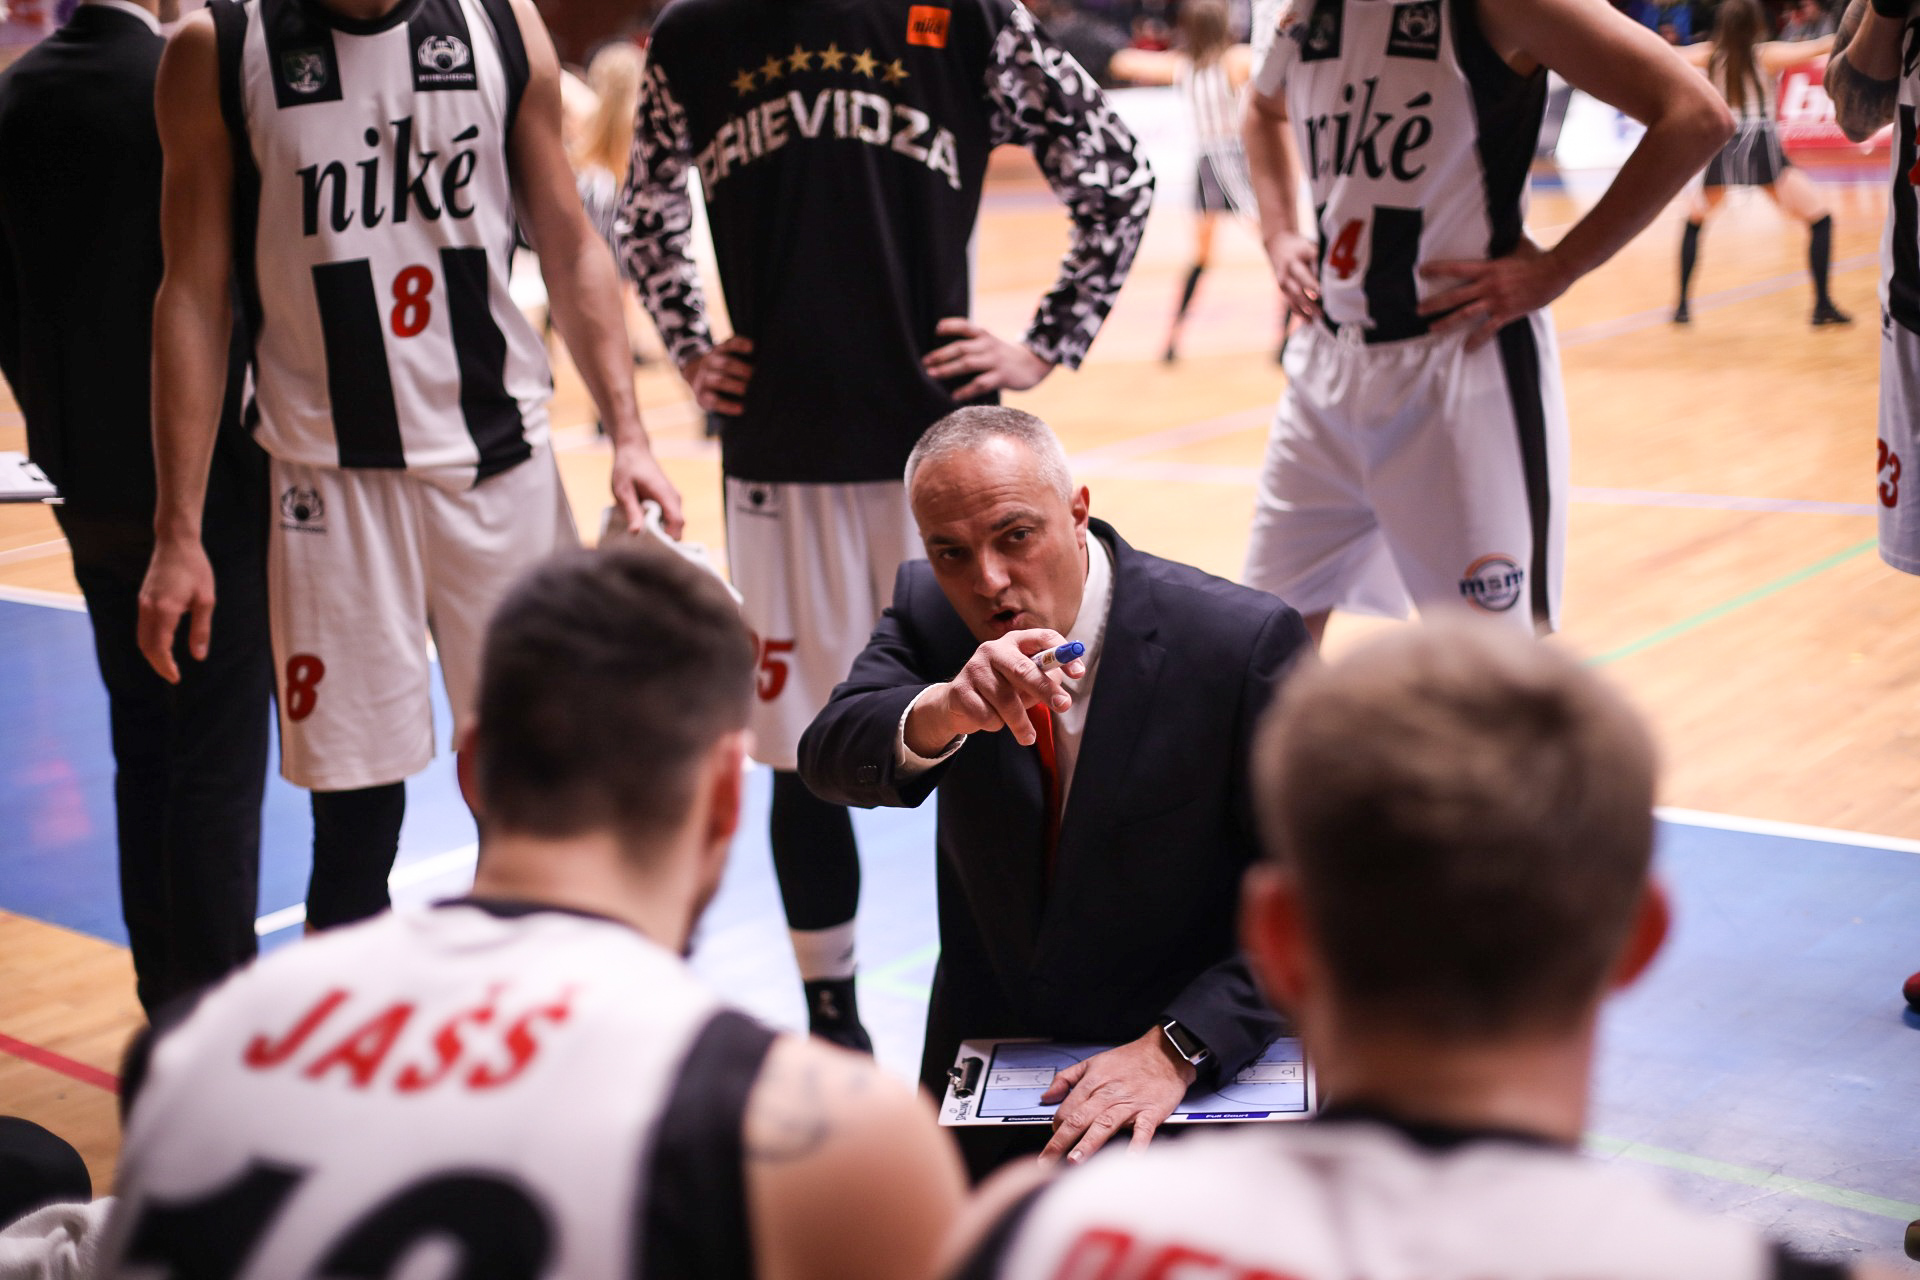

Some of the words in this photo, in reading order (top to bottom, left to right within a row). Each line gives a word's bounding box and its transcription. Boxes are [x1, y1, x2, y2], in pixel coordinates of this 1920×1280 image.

[295, 115, 479, 237] niké
[1330, 218, 1364, 280] 4
[390, 264, 433, 338] 8
[286, 652, 325, 723] 8
[751, 631, 795, 703] 5
